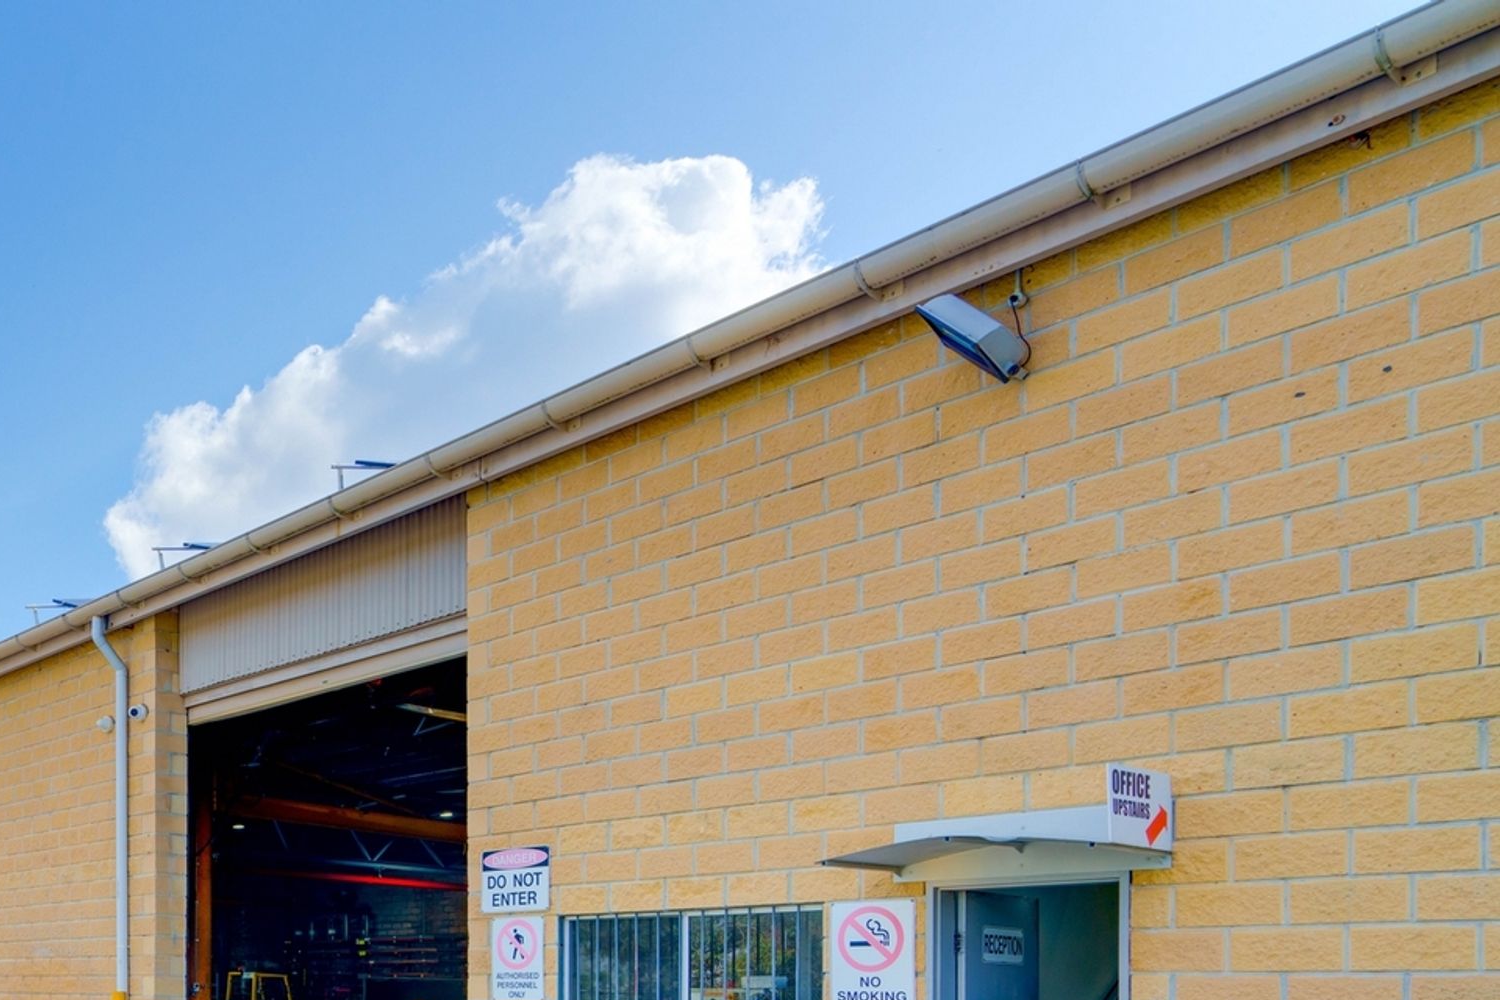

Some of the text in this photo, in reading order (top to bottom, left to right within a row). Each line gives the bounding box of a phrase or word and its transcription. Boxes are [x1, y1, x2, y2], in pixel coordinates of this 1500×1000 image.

[1112, 769, 1150, 799] OFFICE
[1113, 798, 1150, 820] UPSTAIRS
[492, 853, 537, 866] DANGER
[487, 871, 543, 890] DO NOT
[491, 890, 538, 908] ENTER
[984, 934, 1024, 956] RECEPTION
[496, 971, 541, 980] AUTHORISED
[859, 976, 881, 988] NO
[496, 981, 539, 989] PERSONNEL
[507, 990, 526, 998] ONLY
